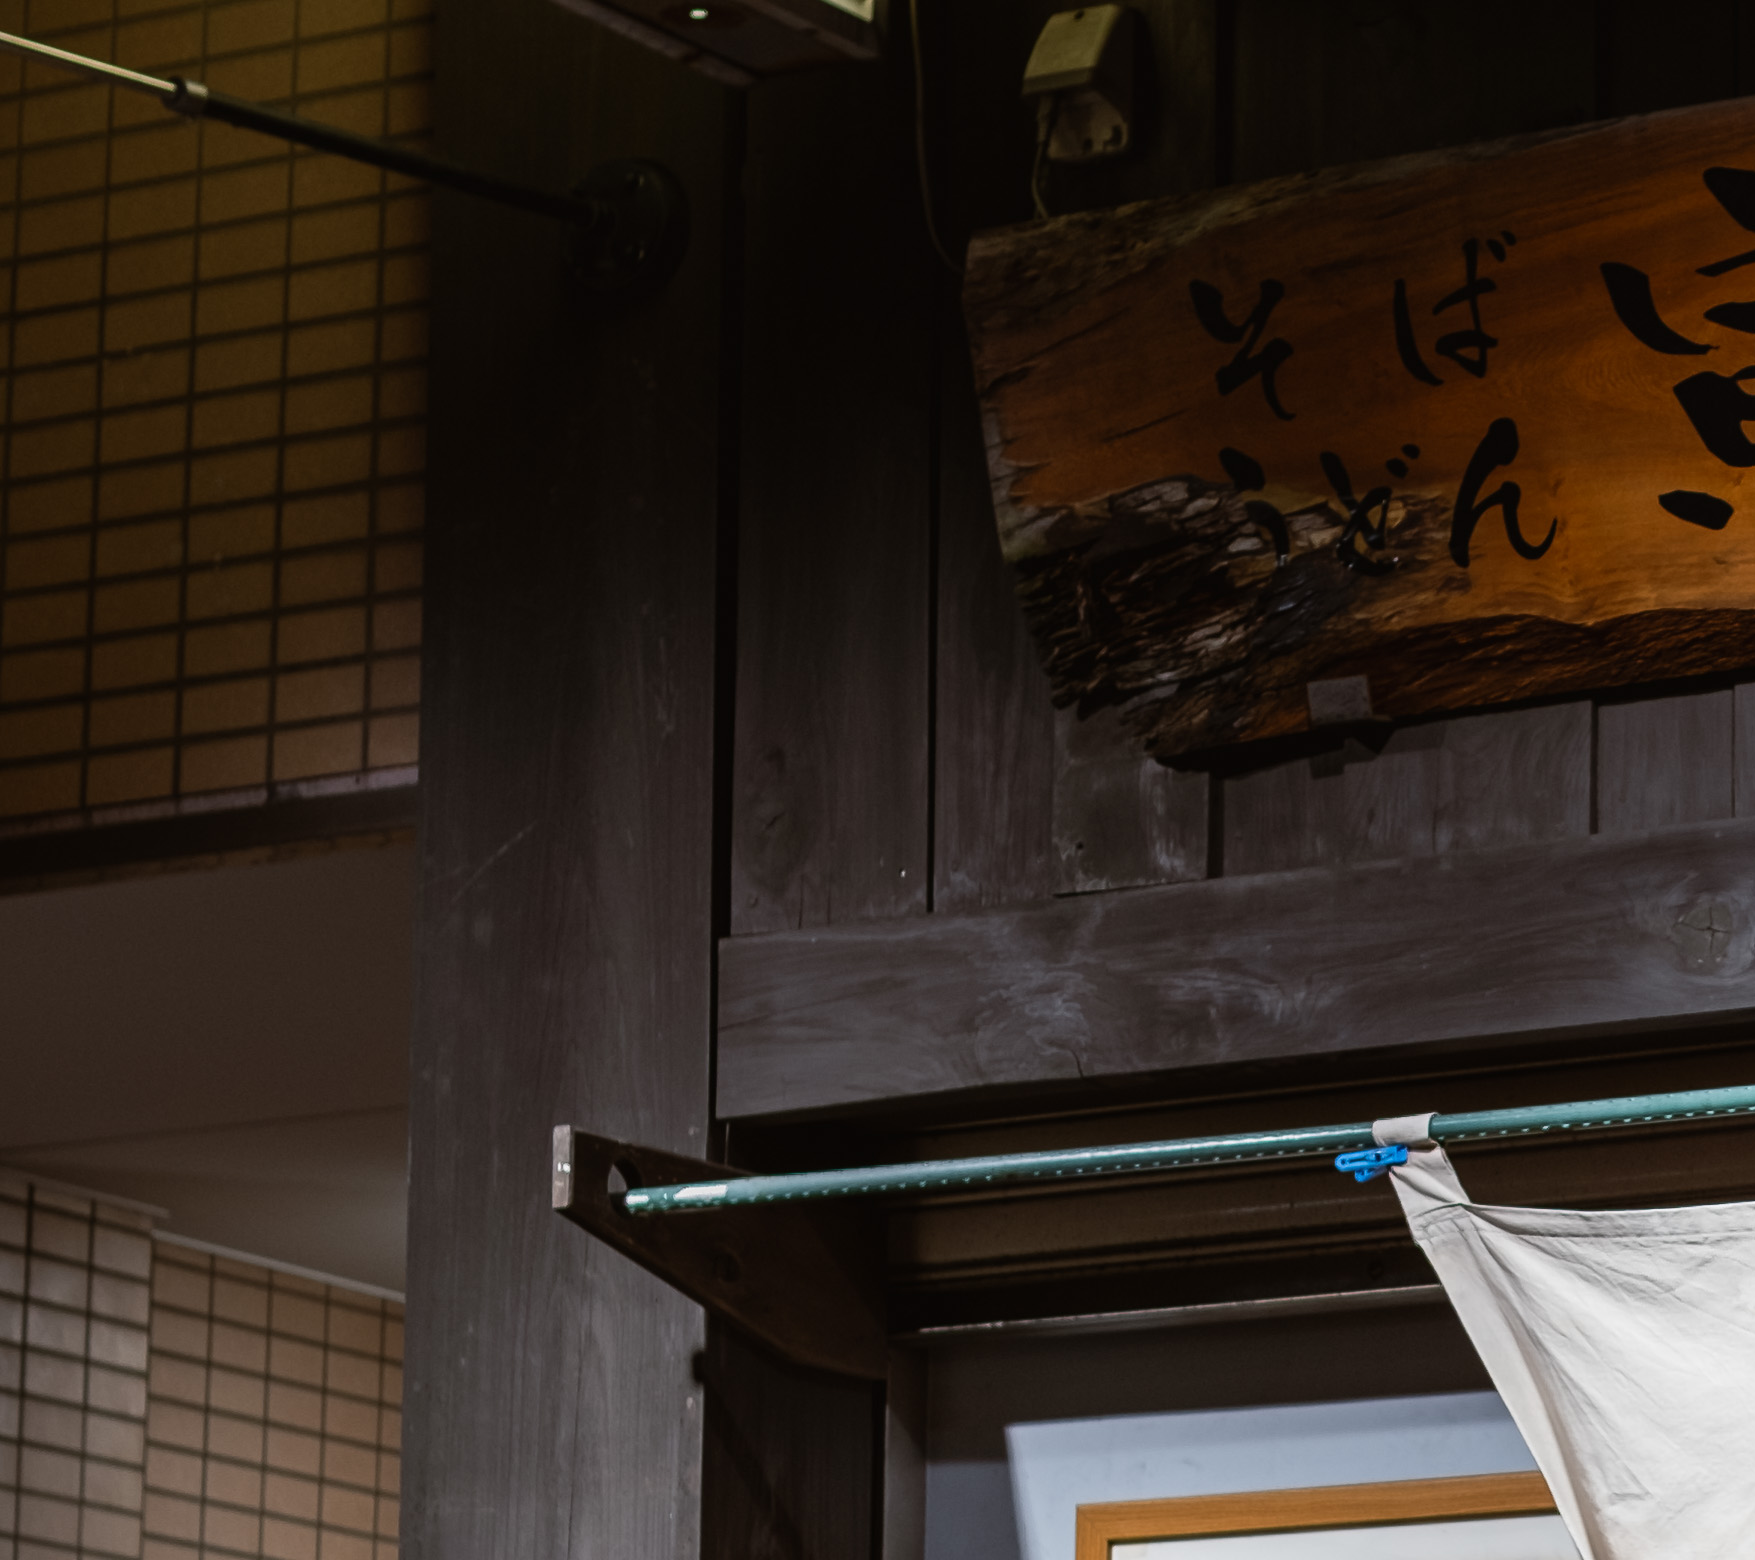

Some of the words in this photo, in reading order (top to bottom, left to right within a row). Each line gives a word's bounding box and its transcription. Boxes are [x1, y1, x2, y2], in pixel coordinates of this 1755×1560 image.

[1190, 230, 1518, 422] そば
[1219, 417, 1558, 577] うどん
